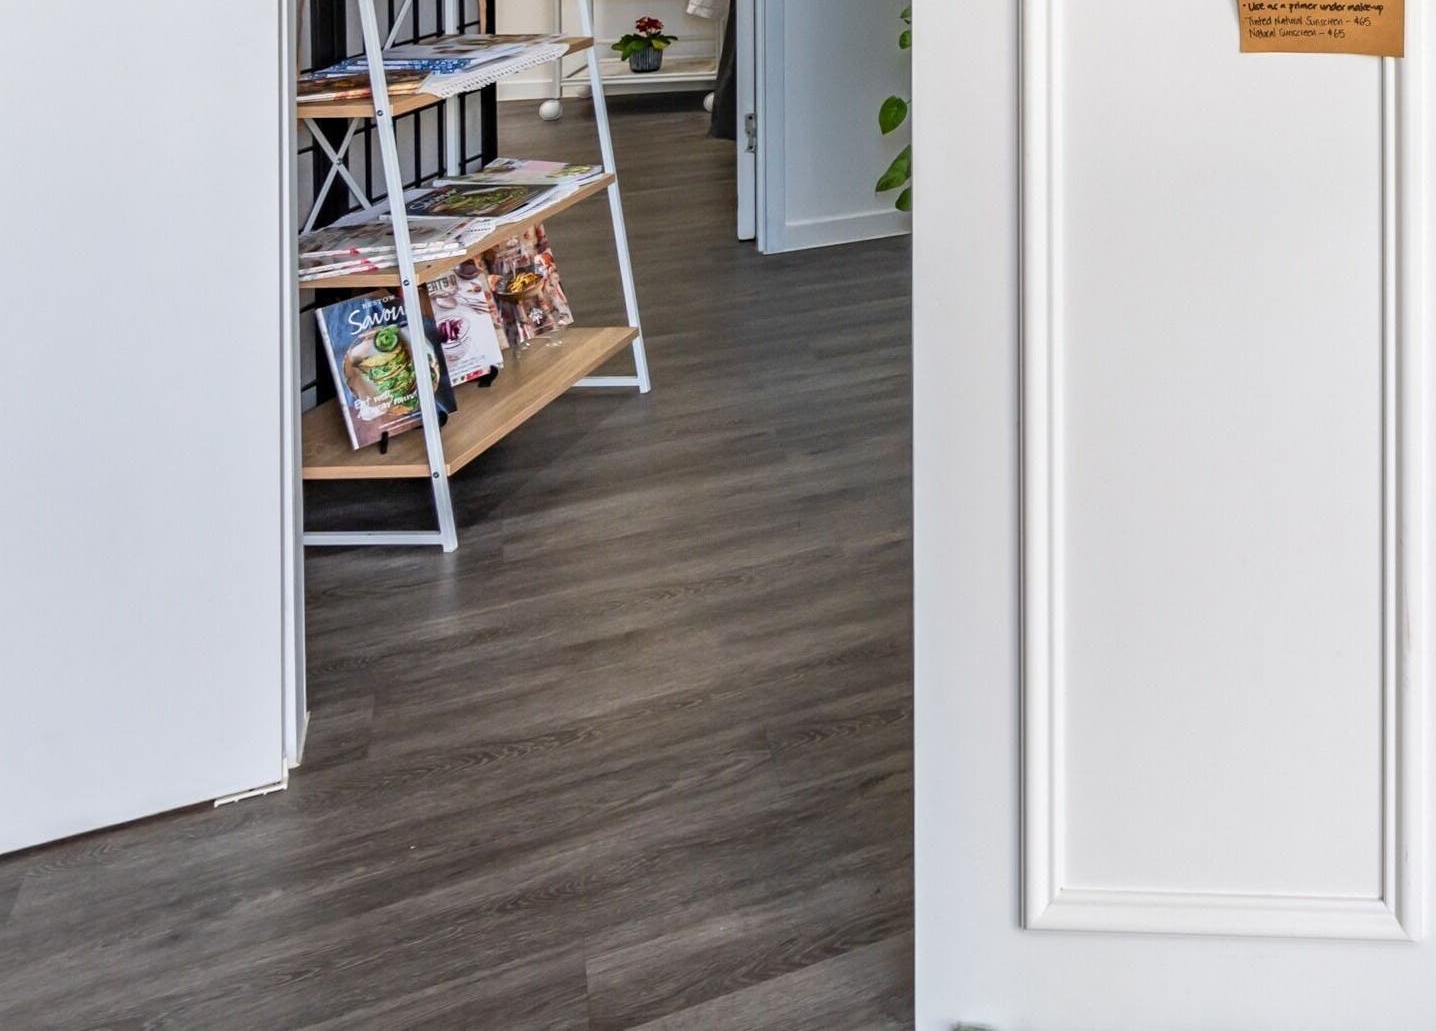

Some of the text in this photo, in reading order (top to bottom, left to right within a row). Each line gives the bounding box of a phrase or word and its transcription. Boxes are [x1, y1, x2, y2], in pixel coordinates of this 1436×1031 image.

[1248, 1, 1265, 11] Use
[1289, 2, 1316, 12] primer
[1320, 2, 1346, 12] under
[1347, 3, 1384, 15] make-up
[1246, 15, 1371, 27] Tinted Natural Sunscreen $65
[1250, 28, 1346, 39] Natural Sunscreen $65
